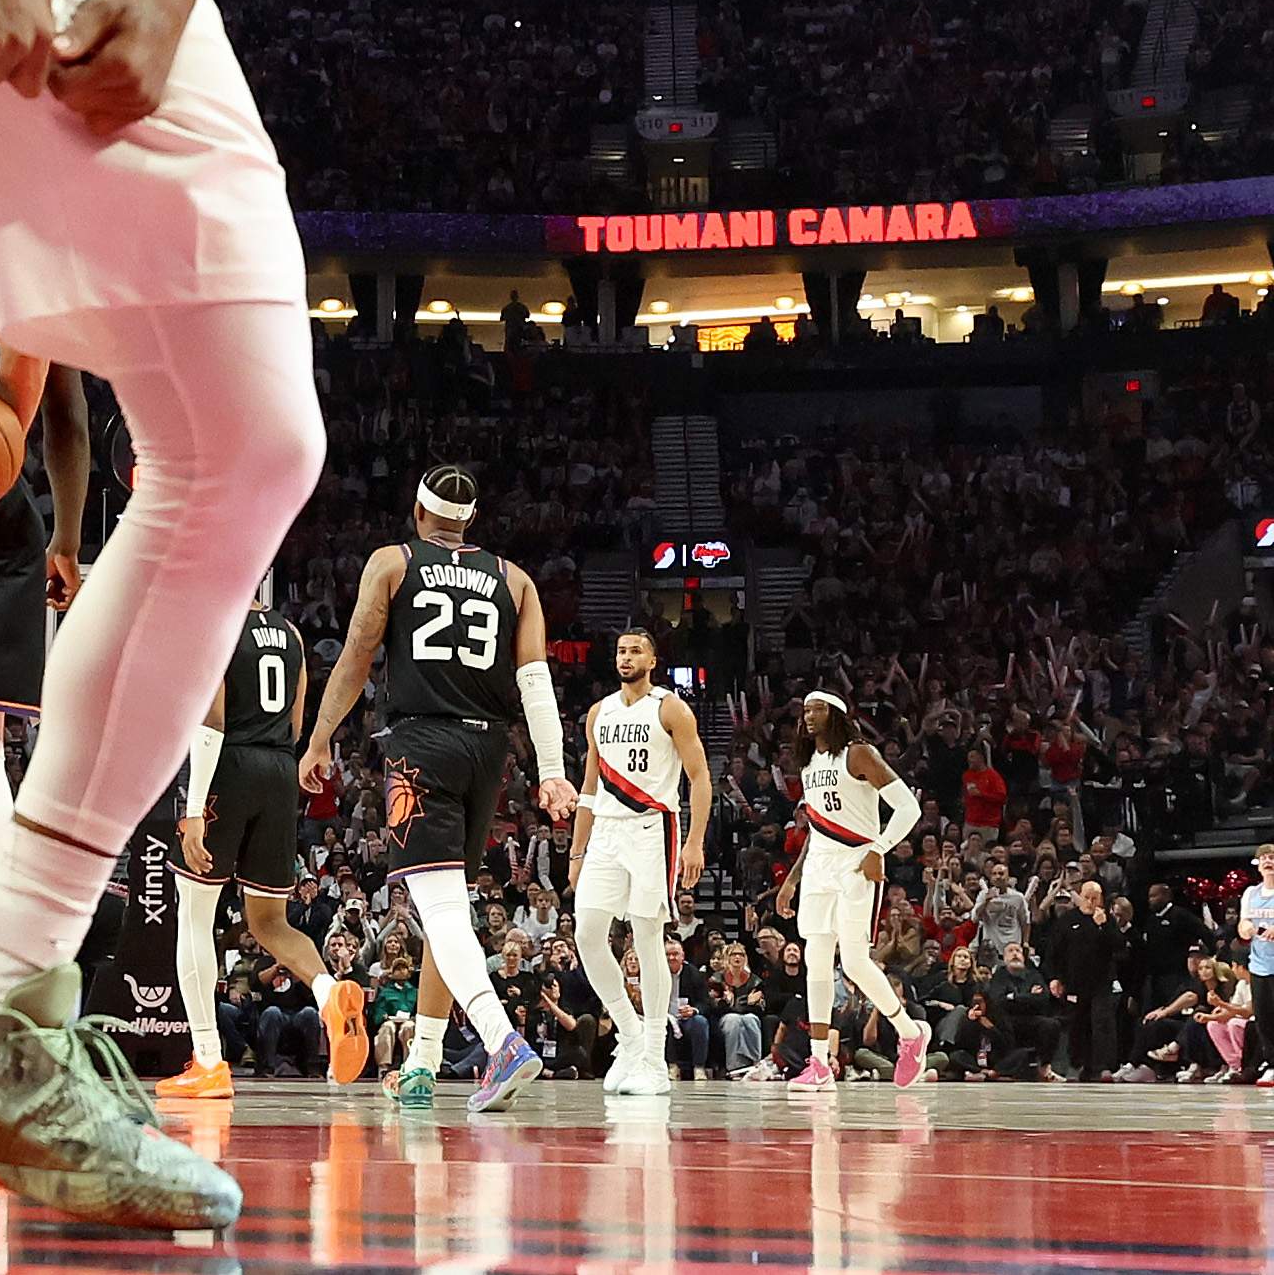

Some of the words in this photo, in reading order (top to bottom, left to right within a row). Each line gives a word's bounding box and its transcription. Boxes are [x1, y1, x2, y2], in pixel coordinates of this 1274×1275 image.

[577, 209, 776, 253] TOUMANI
[788, 201, 977, 246] CAMARA
[420, 564, 498, 596] GOODWIN
[253, 628, 287, 650] DUNN
[412, 592, 500, 671] 23
[259, 654, 285, 713] 0
[599, 723, 650, 745] BLAZERS
[628, 749, 649, 773] 33
[824, 791, 842, 812] 35
[138, 834, 168, 925] xfinity
